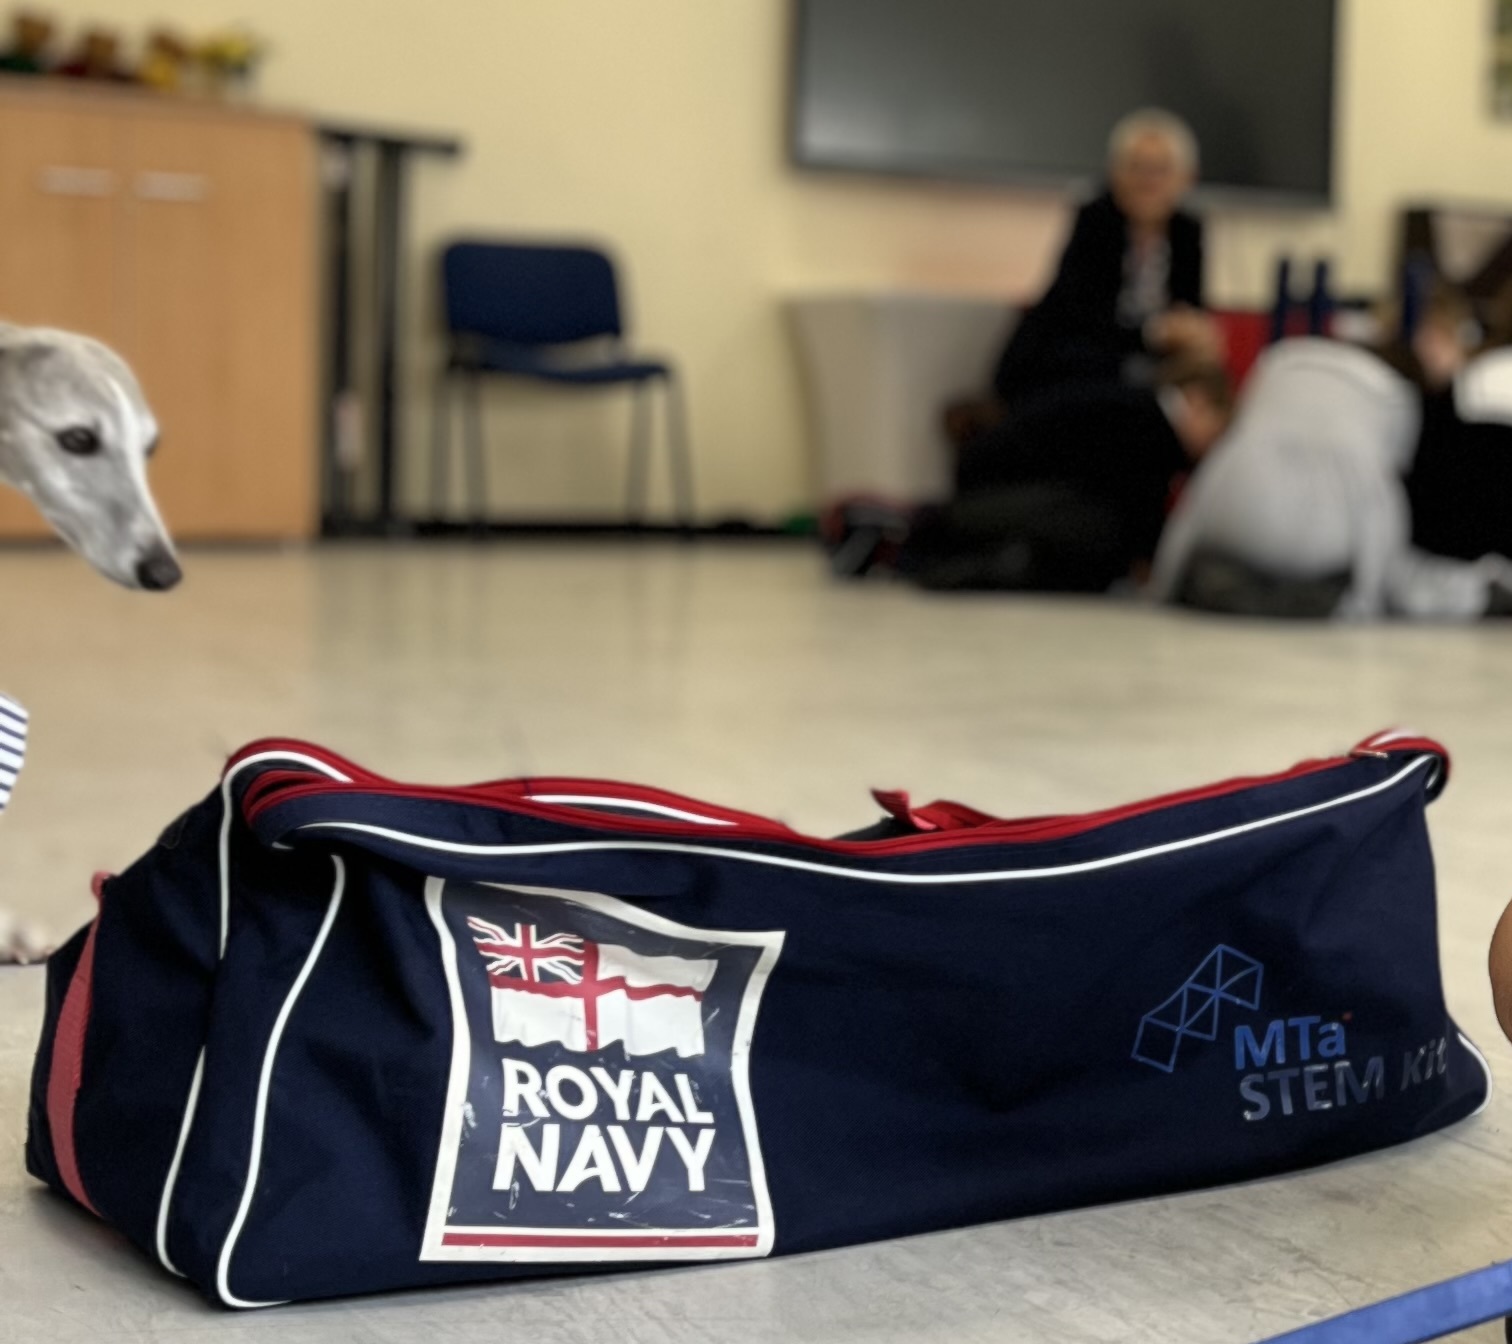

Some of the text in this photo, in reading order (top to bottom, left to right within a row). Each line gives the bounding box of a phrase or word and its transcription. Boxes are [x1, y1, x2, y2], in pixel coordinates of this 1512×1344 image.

[1234, 1015, 1347, 1070] MTa
[501, 1057, 715, 1124] ROYAL
[1239, 1055, 1386, 1122] STEM
[491, 1122, 717, 1193] NAVY
